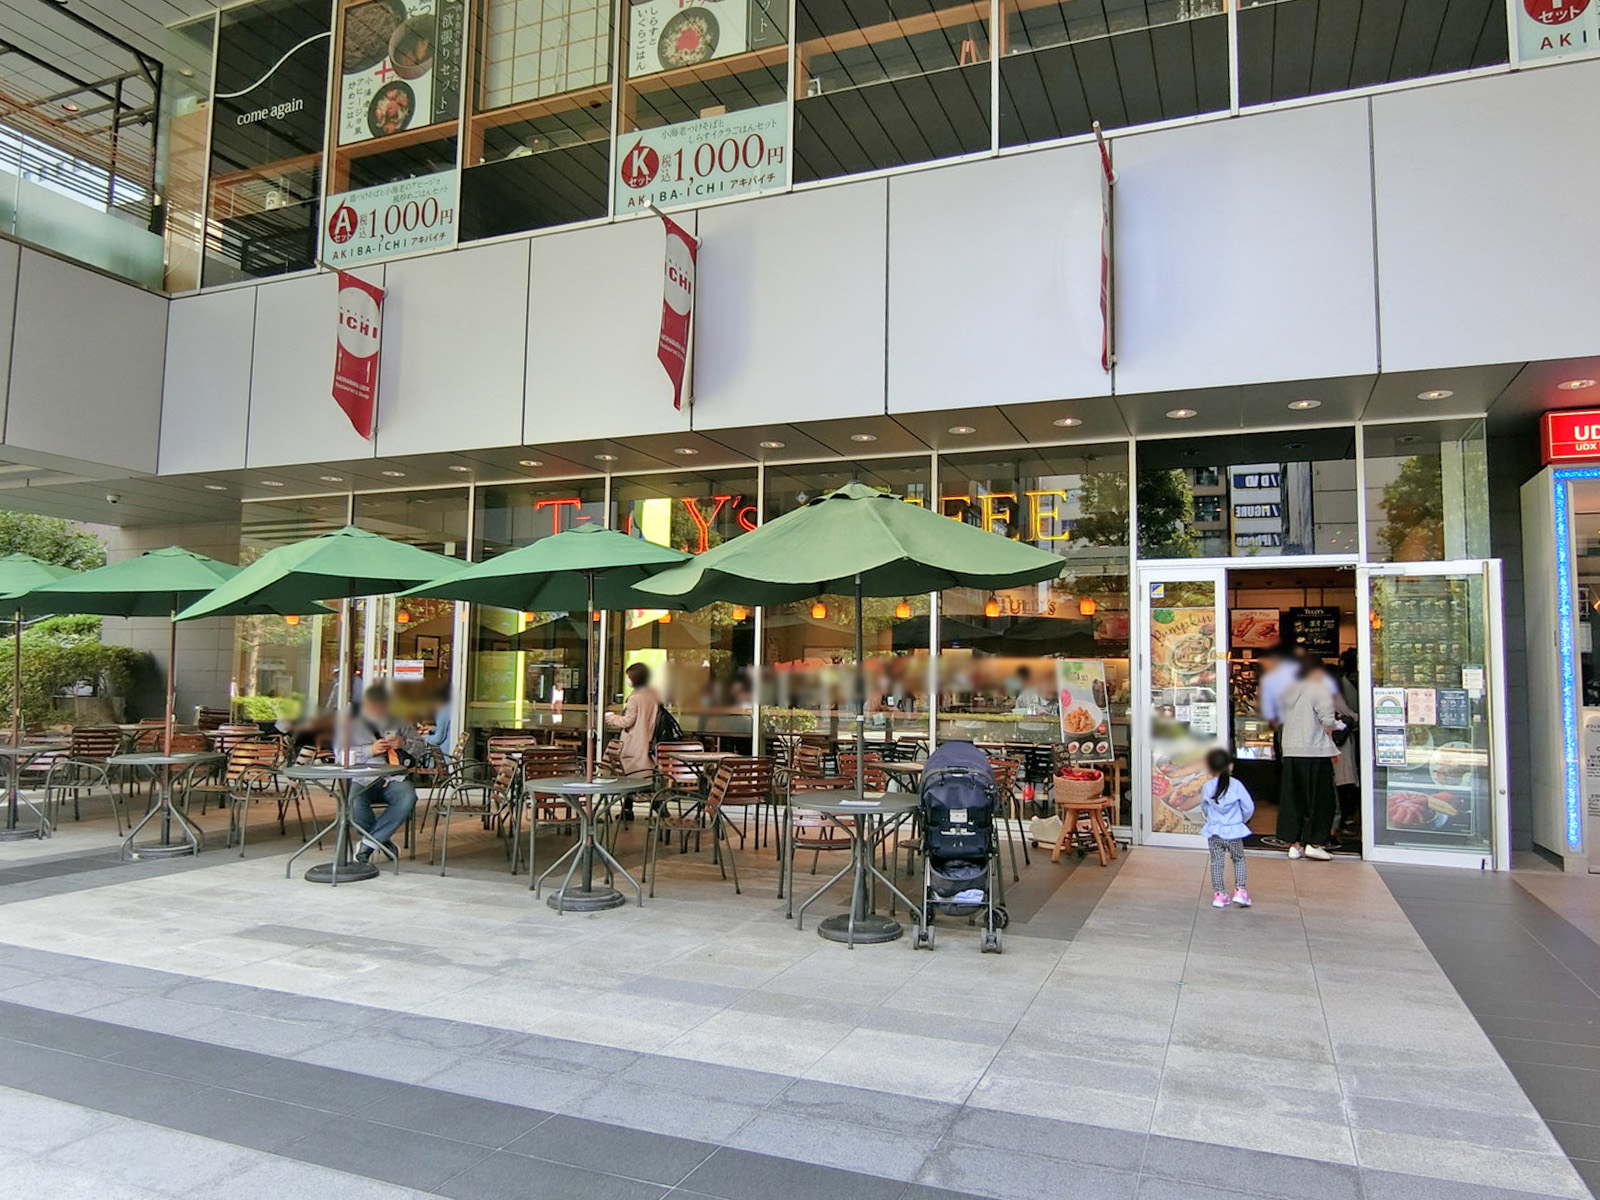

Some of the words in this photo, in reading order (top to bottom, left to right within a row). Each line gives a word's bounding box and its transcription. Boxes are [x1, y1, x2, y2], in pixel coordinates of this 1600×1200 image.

[1537, 5, 1581, 24] セット
[1540, 27, 1600, 50] AKI
[236, 107, 269, 127] come
[269, 96, 304, 120] again
[631, 147, 650, 178] K
[730, 173, 776, 189] アキバイチ
[627, 181, 724, 208] AKIBA-ICHI
[334, 208, 352, 235] A
[332, 238, 407, 261] AKIBA-ICHI
[339, 312, 378, 339] ICHI
[1575, 443, 1597, 451] UDX
